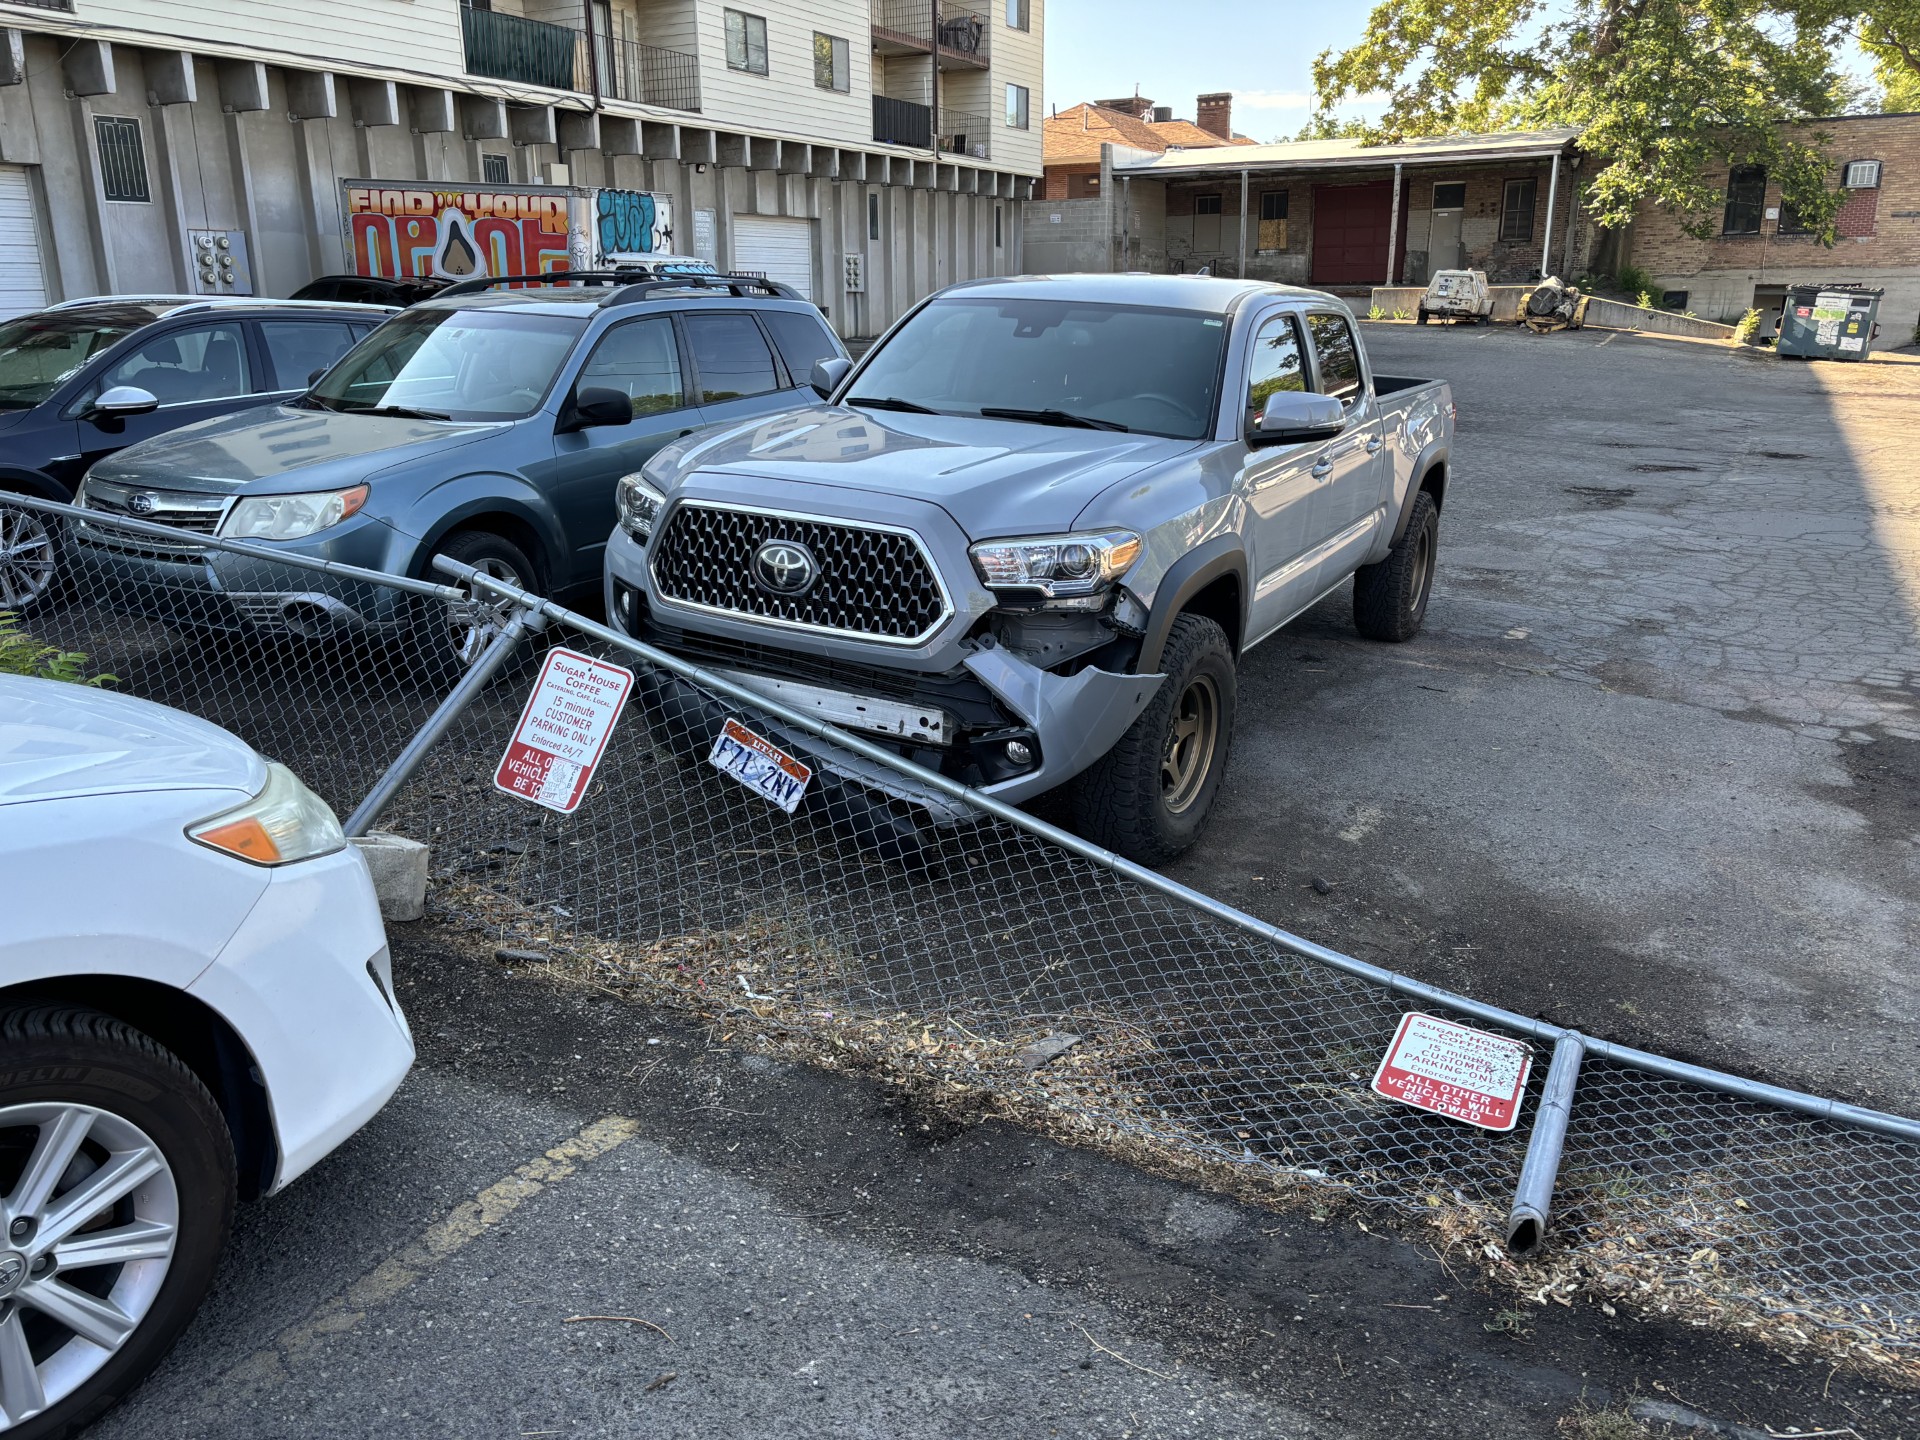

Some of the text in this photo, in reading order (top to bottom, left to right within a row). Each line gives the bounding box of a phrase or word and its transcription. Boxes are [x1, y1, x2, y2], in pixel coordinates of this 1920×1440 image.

[350, 189, 434, 216] FIND
[463, 193, 568, 234] YOUR
[553, 661, 621, 691] SUGAR HOUSE
[565, 677, 602, 695] COFFEE
[545, 707, 592, 731] CUSTOMER
[553, 696, 595, 718] 15 minute
[530, 716, 596, 747] PARKING ONLY
[522, 749, 541, 766] ALL
[531, 733, 584, 758] Enforced 24/7
[751, 739, 783, 764] UTAH
[508, 759, 550, 783] VEHICLE
[513, 776, 529, 791] BE
[760, 766, 799, 801] 2NV
[1416, 1021, 1518, 1054] SUGAR HOUSE
[1438, 1033, 1492, 1053] COFFEE
[1421, 1050, 1493, 1074] CUSTOMER
[1428, 1044, 1493, 1067] 15 minute
[1404, 1052, 1506, 1086] PARKING ONLY
[1411, 1064, 1458, 1082] Enforced
[1387, 1076, 1505, 1118] VEHICLES WILL
[1405, 1074, 1491, 1105] ALL OTHER
[1402, 1090, 1481, 1120] BE TOWED
